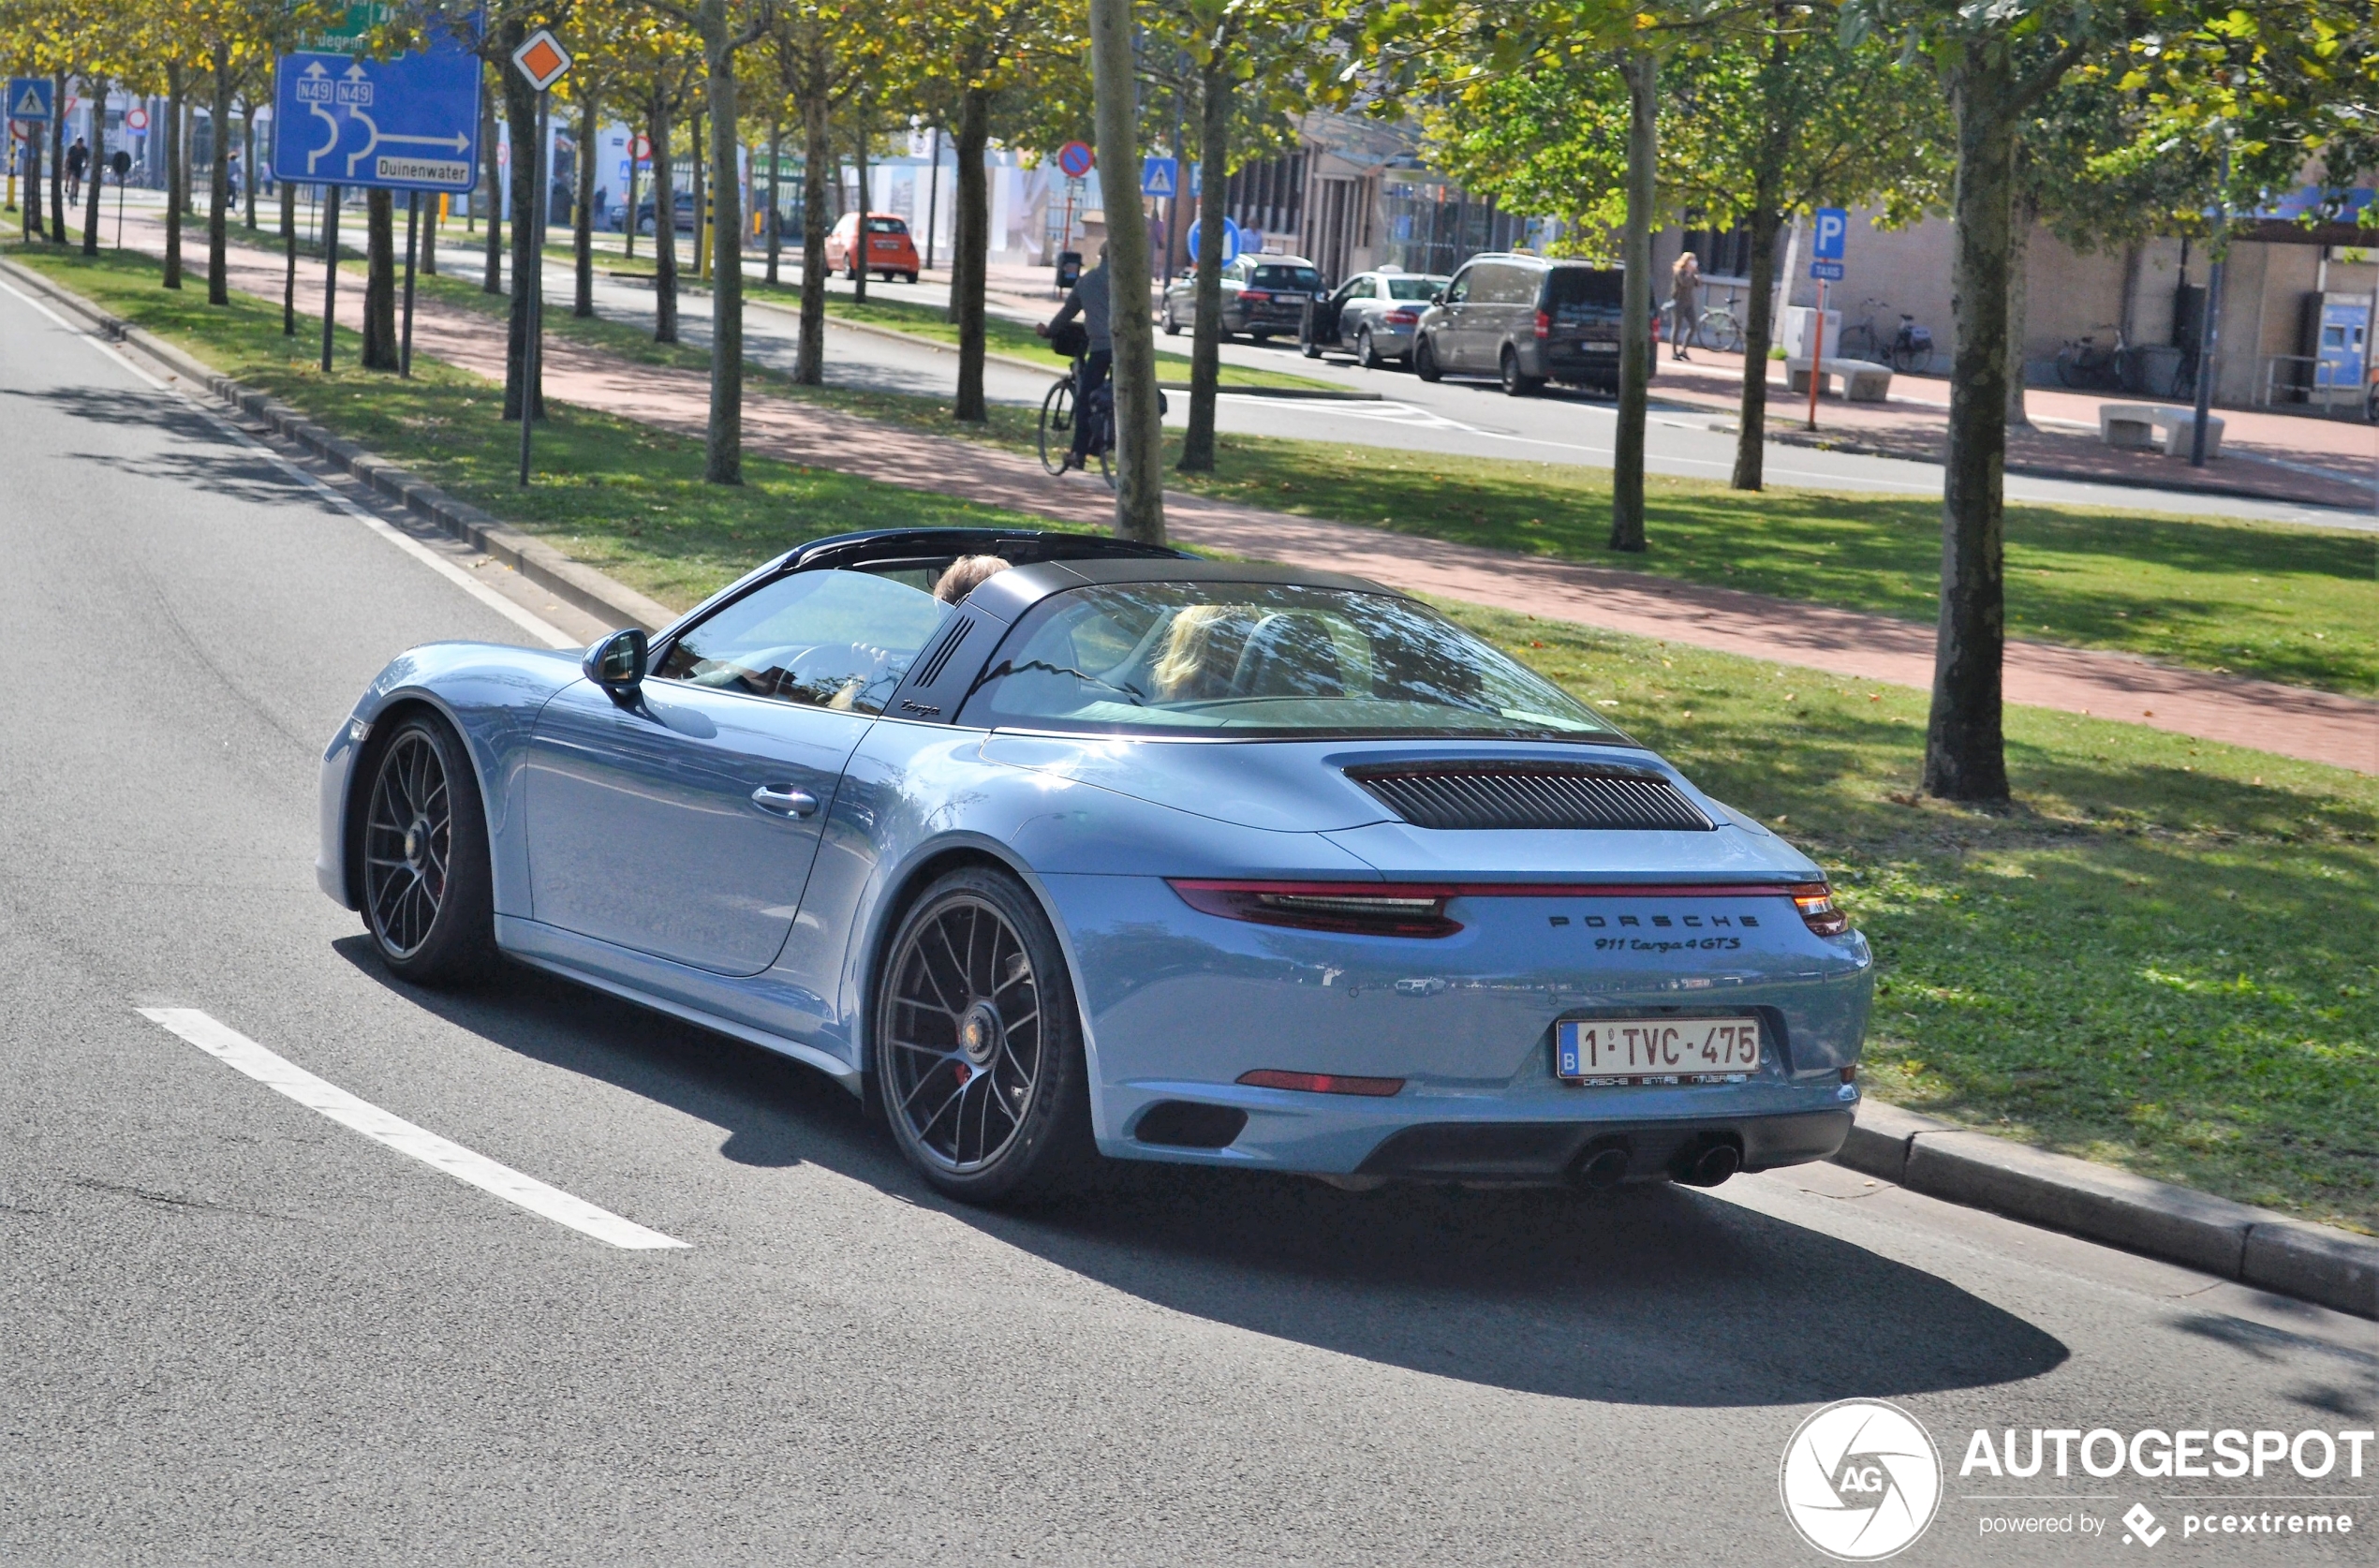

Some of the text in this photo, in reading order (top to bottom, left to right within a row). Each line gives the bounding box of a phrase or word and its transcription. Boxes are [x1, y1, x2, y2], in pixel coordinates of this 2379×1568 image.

[300, 80, 328, 100] N49
[339, 81, 370, 102] N49
[379, 160, 465, 180] Duinenwater
[1819, 215, 1841, 250] P
[901, 699, 940, 717] targa
[1548, 915, 1759, 927] PORSCHE
[1594, 938, 1626, 950] 911
[1699, 938, 1741, 950] GTS
[1586, 1027, 1755, 1067] 1-TVC-475
[1563, 1053, 1575, 1070] B
[1577, 1077, 1628, 1087] ORSCHE
